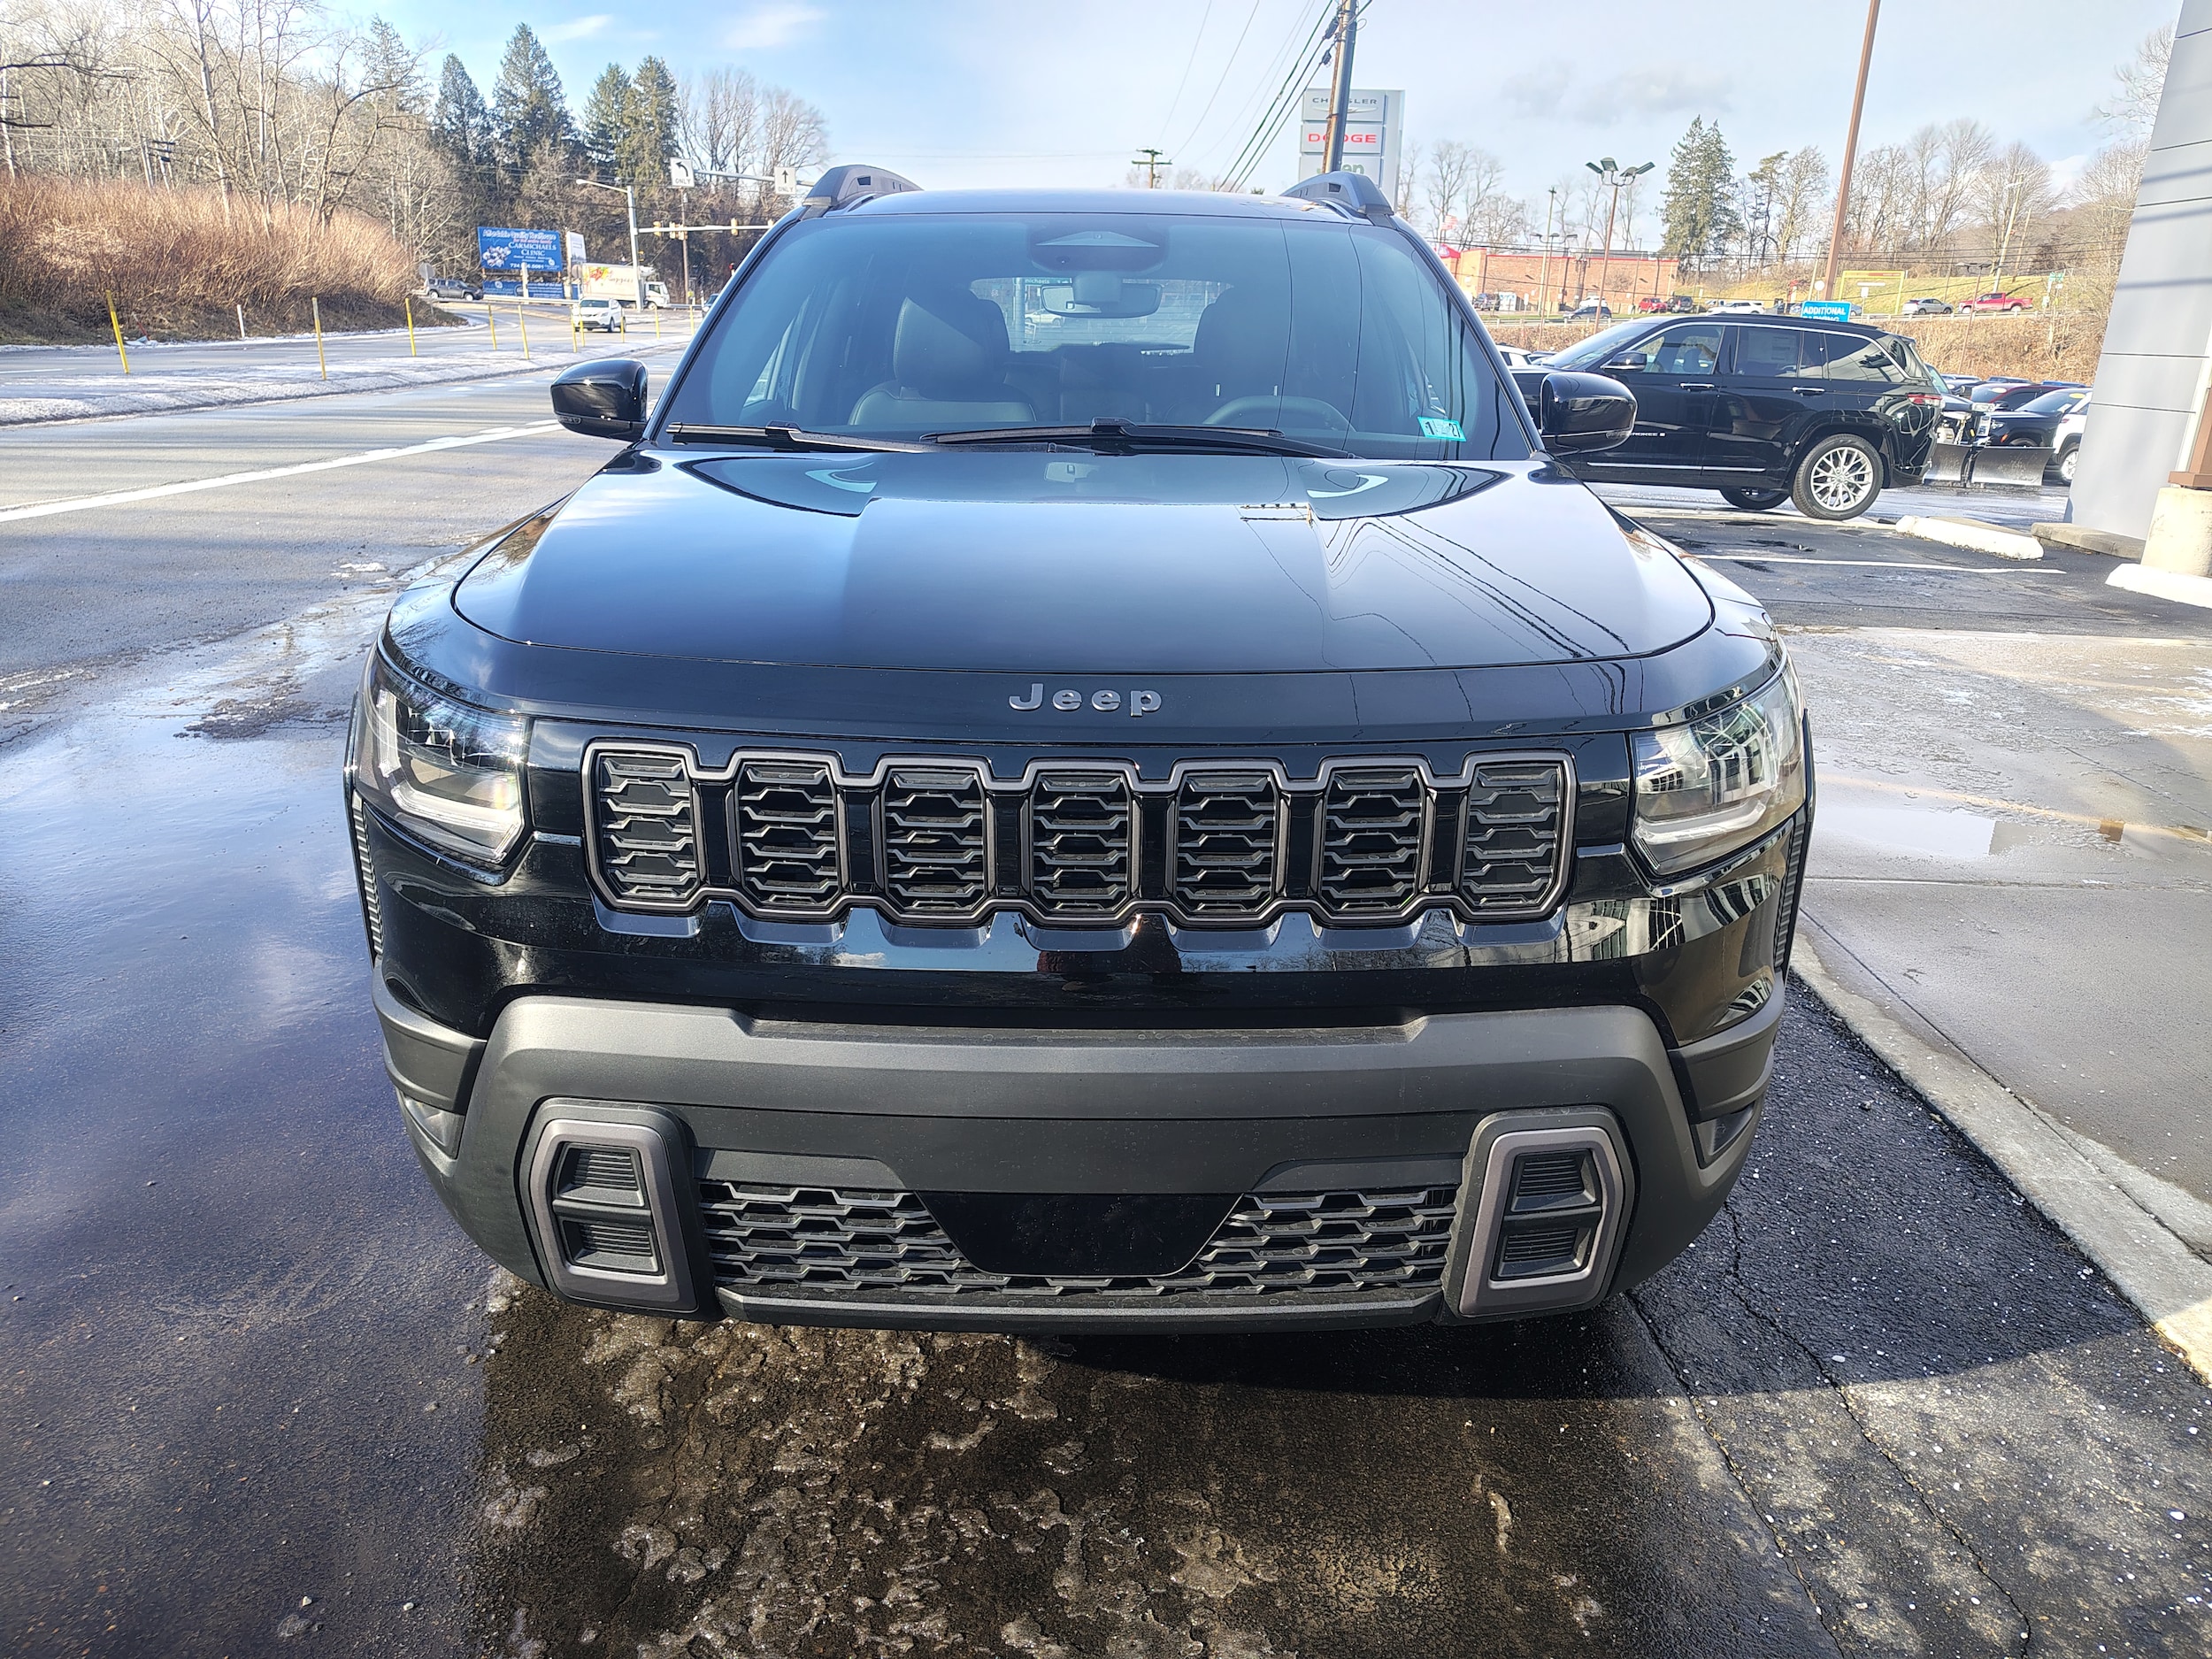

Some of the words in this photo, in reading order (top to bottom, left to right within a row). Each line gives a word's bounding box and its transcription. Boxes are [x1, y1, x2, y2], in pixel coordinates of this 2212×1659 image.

[508, 242, 557, 250] CARMICHAELS
[1802, 306, 1846, 315] ADDITIONAL
[1009, 683, 1163, 717] Jeep
